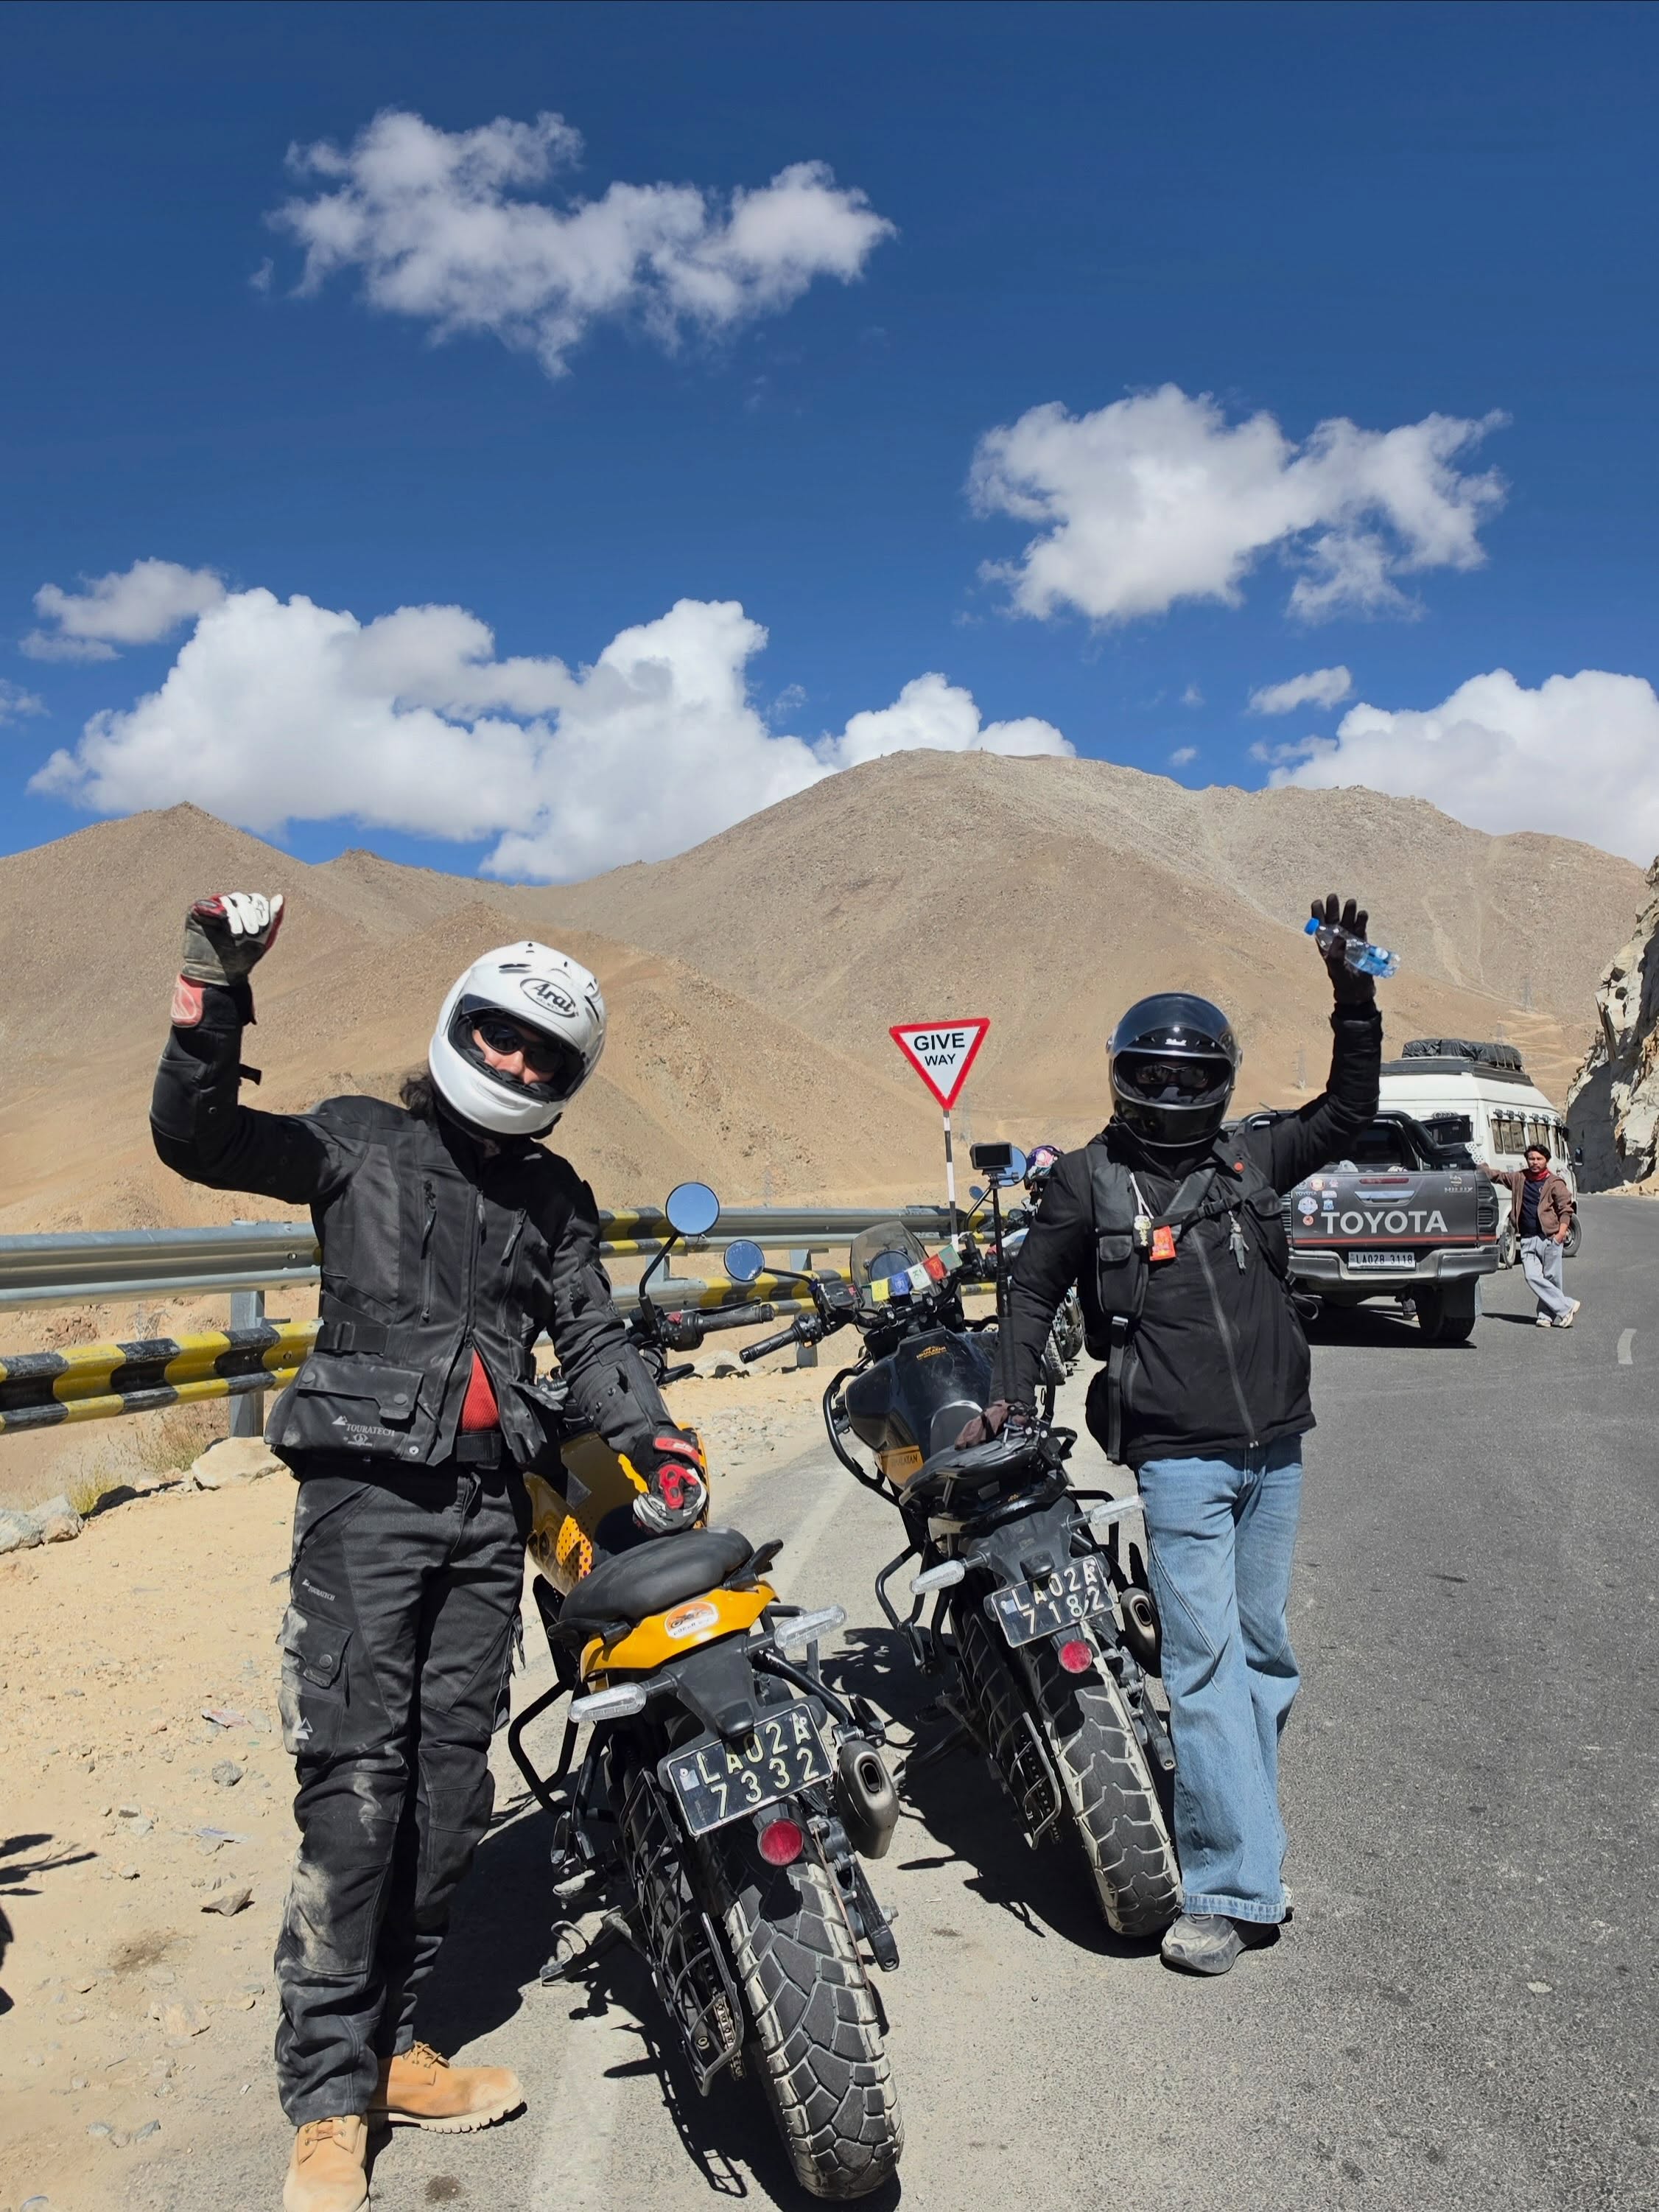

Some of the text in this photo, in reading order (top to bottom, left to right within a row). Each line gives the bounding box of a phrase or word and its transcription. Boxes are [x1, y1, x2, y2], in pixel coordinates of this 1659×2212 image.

[530, 983, 575, 1012] Arai
[913, 1032, 965, 1051] GIVE
[925, 1054, 956, 1066] WAY
[1321, 1211, 1448, 1234] TOYOTA
[1390, 1254, 1413, 1264] 3118
[346, 1424, 396, 1437] TOURATECH
[1011, 1560, 1098, 1611] LA02A
[1023, 1586, 1104, 1634] 7182
[695, 1712, 811, 1785] LA02A
[710, 1747, 819, 1819] 7332
